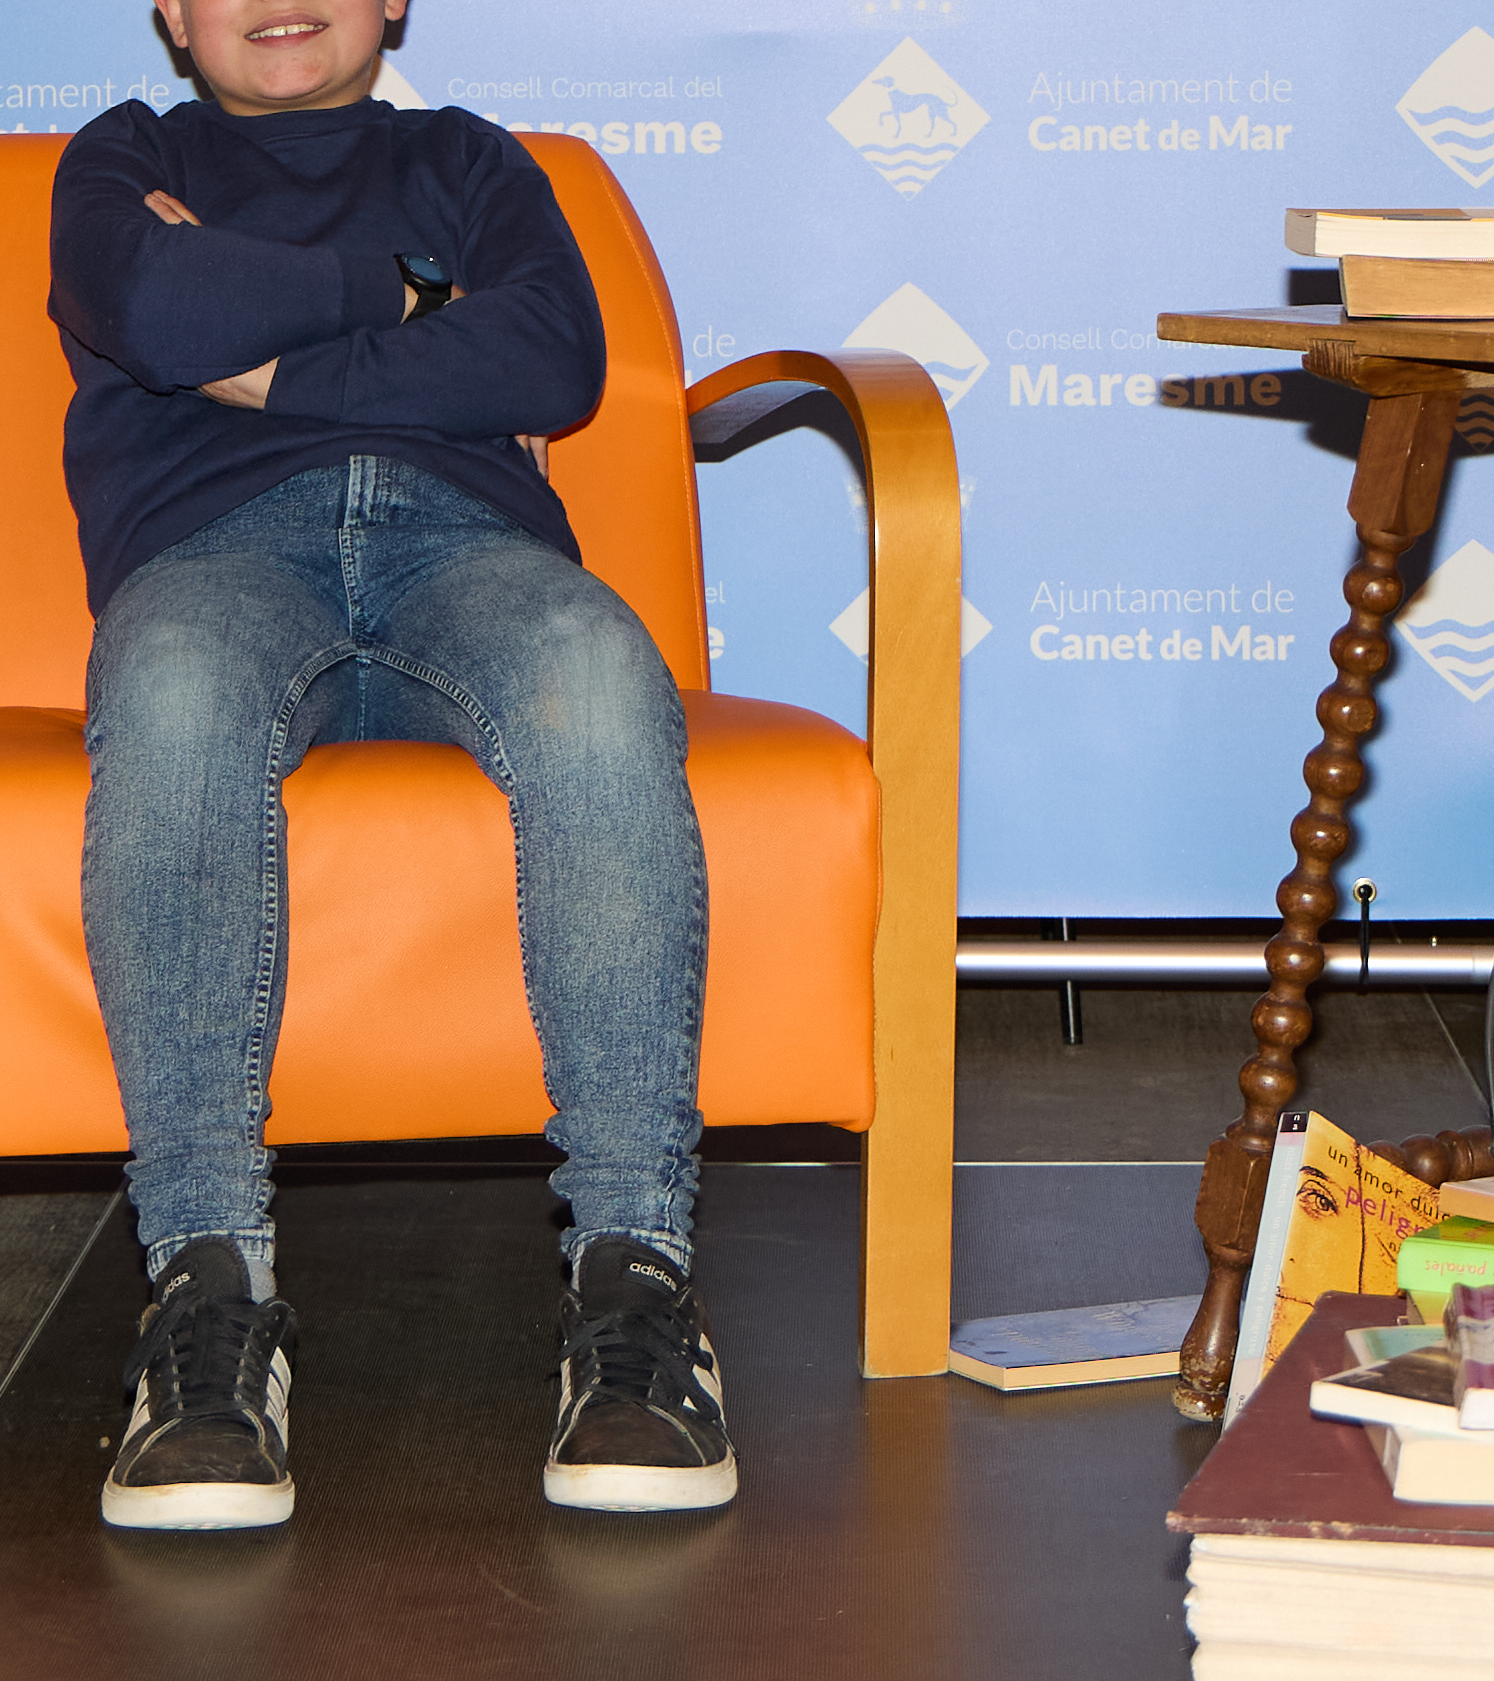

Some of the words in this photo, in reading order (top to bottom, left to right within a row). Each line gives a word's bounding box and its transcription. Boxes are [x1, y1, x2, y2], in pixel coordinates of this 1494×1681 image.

[447, 76, 542, 98] Consell
[551, 76, 676, 98] Comarcal
[685, 76, 723, 99] del
[1027, 71, 1238, 107] Ajuntament
[1249, 71, 1293, 104] de
[1028, 115, 1150, 151] Canet
[1159, 120, 1201, 152] de
[1208, 117, 1290, 152] Mar
[1006, 328, 1101, 349] Consell
[1009, 366, 1281, 407] Maresme
[1029, 580, 1240, 616] Ajuntament
[1251, 581, 1295, 614] de
[1030, 624, 1152, 660] Canet
[1161, 629, 1203, 661] de
[1210, 627, 1292, 662] Mar
[1275, 1174, 1292, 1207] french
[1328, 1146, 1348, 1167] un
[1354, 1168, 1403, 1199] amor
[1410, 1196, 1451, 1221] dulc
[629, 1262, 677, 1291] adidas
[1425, 1260, 1487, 1277] pañales
